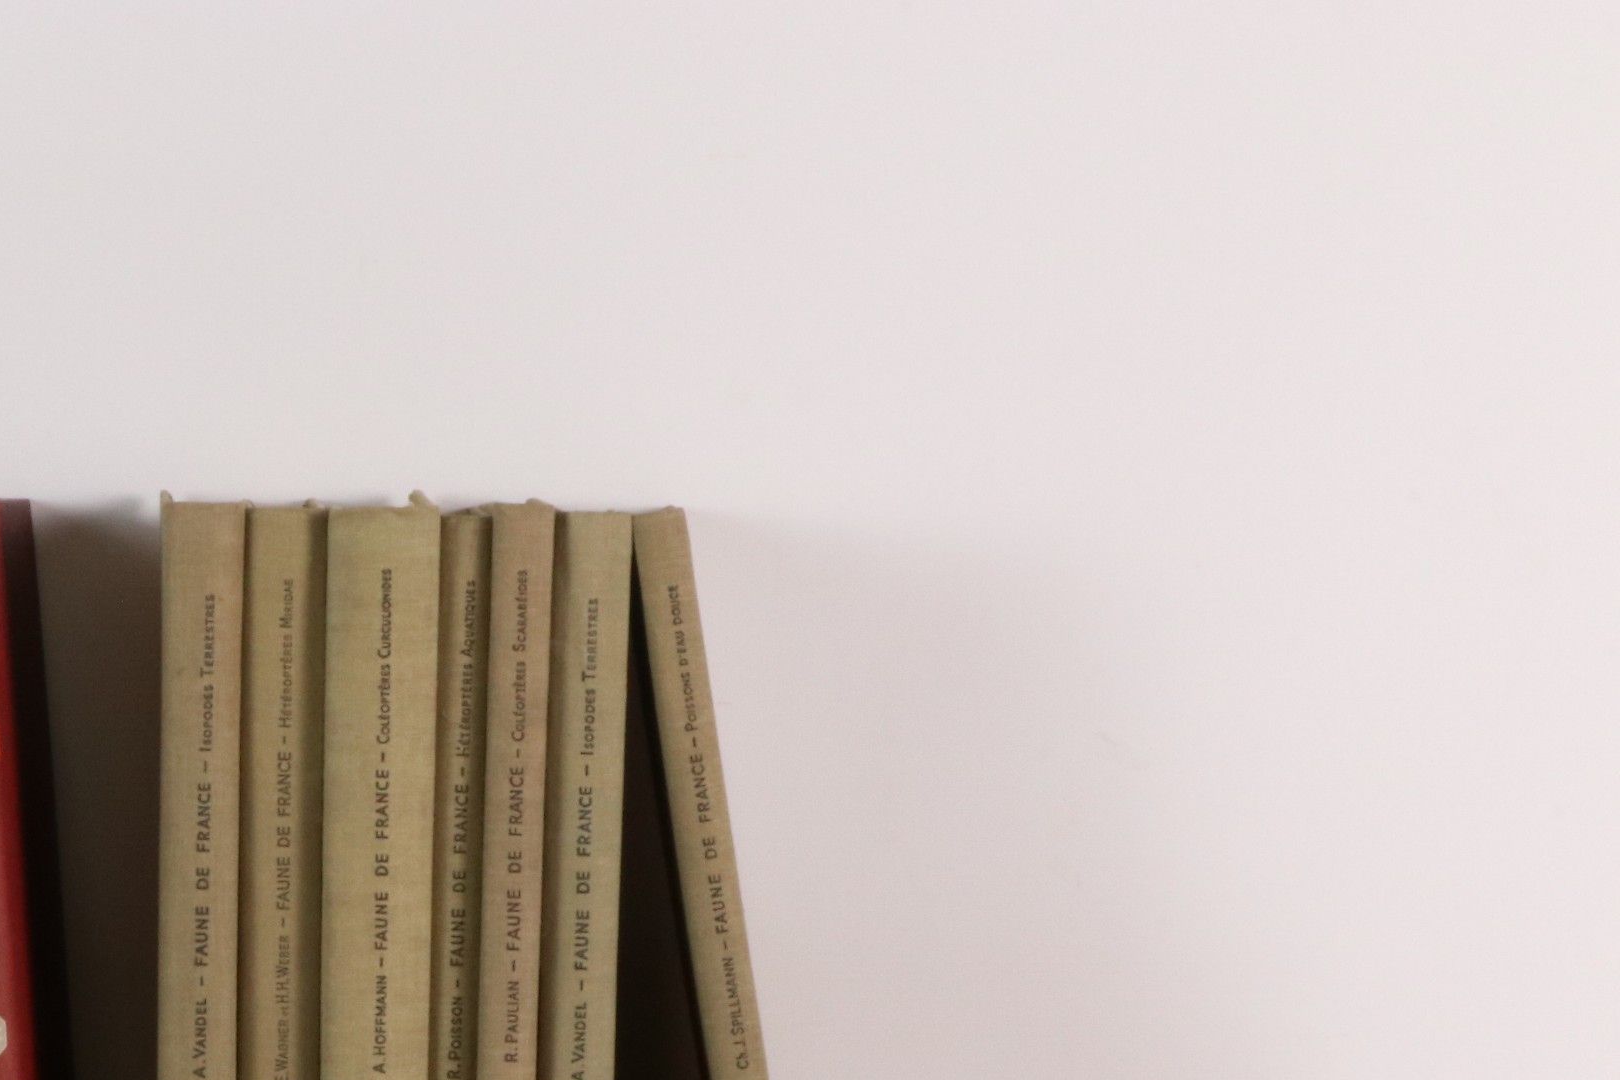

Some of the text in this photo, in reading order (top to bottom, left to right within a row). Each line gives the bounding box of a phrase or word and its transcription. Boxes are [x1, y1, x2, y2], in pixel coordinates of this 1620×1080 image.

[277, 752, 292, 817] FRANCE
[375, 770, 389, 840] FRANCE
[508, 768, 524, 836] FRANCE
[690, 754, 711, 824] FRANCE
[196, 784, 211, 853] FRANCE
[276, 827, 291, 848] DE
[453, 782, 471, 856] FRANCE
[576, 787, 592, 857] FRANCE
[702, 836, 718, 860] DE
[196, 868, 210, 890] DE
[276, 857, 291, 910] FAUNE
[374, 855, 389, 877] DE
[453, 869, 469, 895] DE
[507, 851, 522, 873] DE
[576, 872, 590, 894] DE
[374, 893, 388, 950] FAUNE
[506, 890, 521, 951] FAUNE
[708, 874, 730, 935] FAUNE
[194, 907, 209, 967] FAUNE
[450, 907, 468, 969] FAUNE
[573, 911, 590, 971] FAUNE
